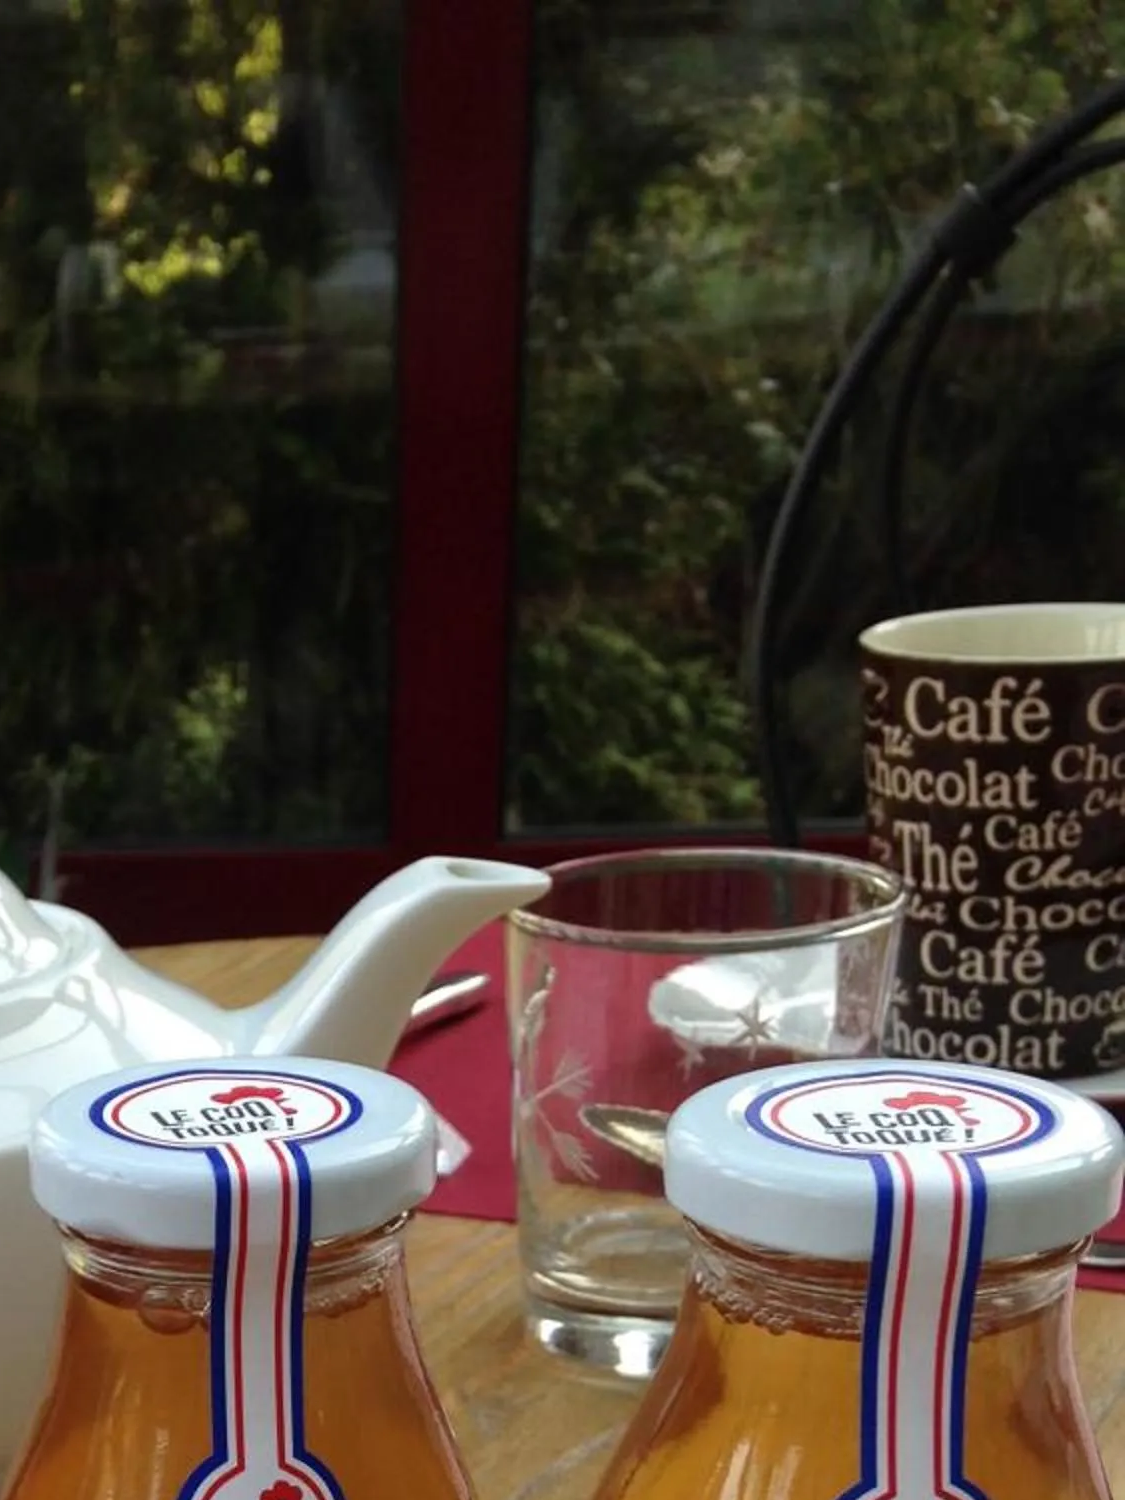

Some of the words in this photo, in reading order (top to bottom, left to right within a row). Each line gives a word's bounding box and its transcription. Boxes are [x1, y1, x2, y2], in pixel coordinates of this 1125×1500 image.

[904, 676, 1052, 744] Café
[865, 743, 1040, 812] Chocolat
[893, 818, 979, 894] Thé
[983, 810, 1083, 851] Café
[920, 930, 1046, 986] Café
[917, 981, 984, 1022] Thé
[890, 1007, 1065, 1071] hocolat
[150, 1108, 194, 1126] LE
[200, 1100, 276, 1122] COQ
[812, 1111, 861, 1128] LE
[869, 1108, 955, 1128] COQ
